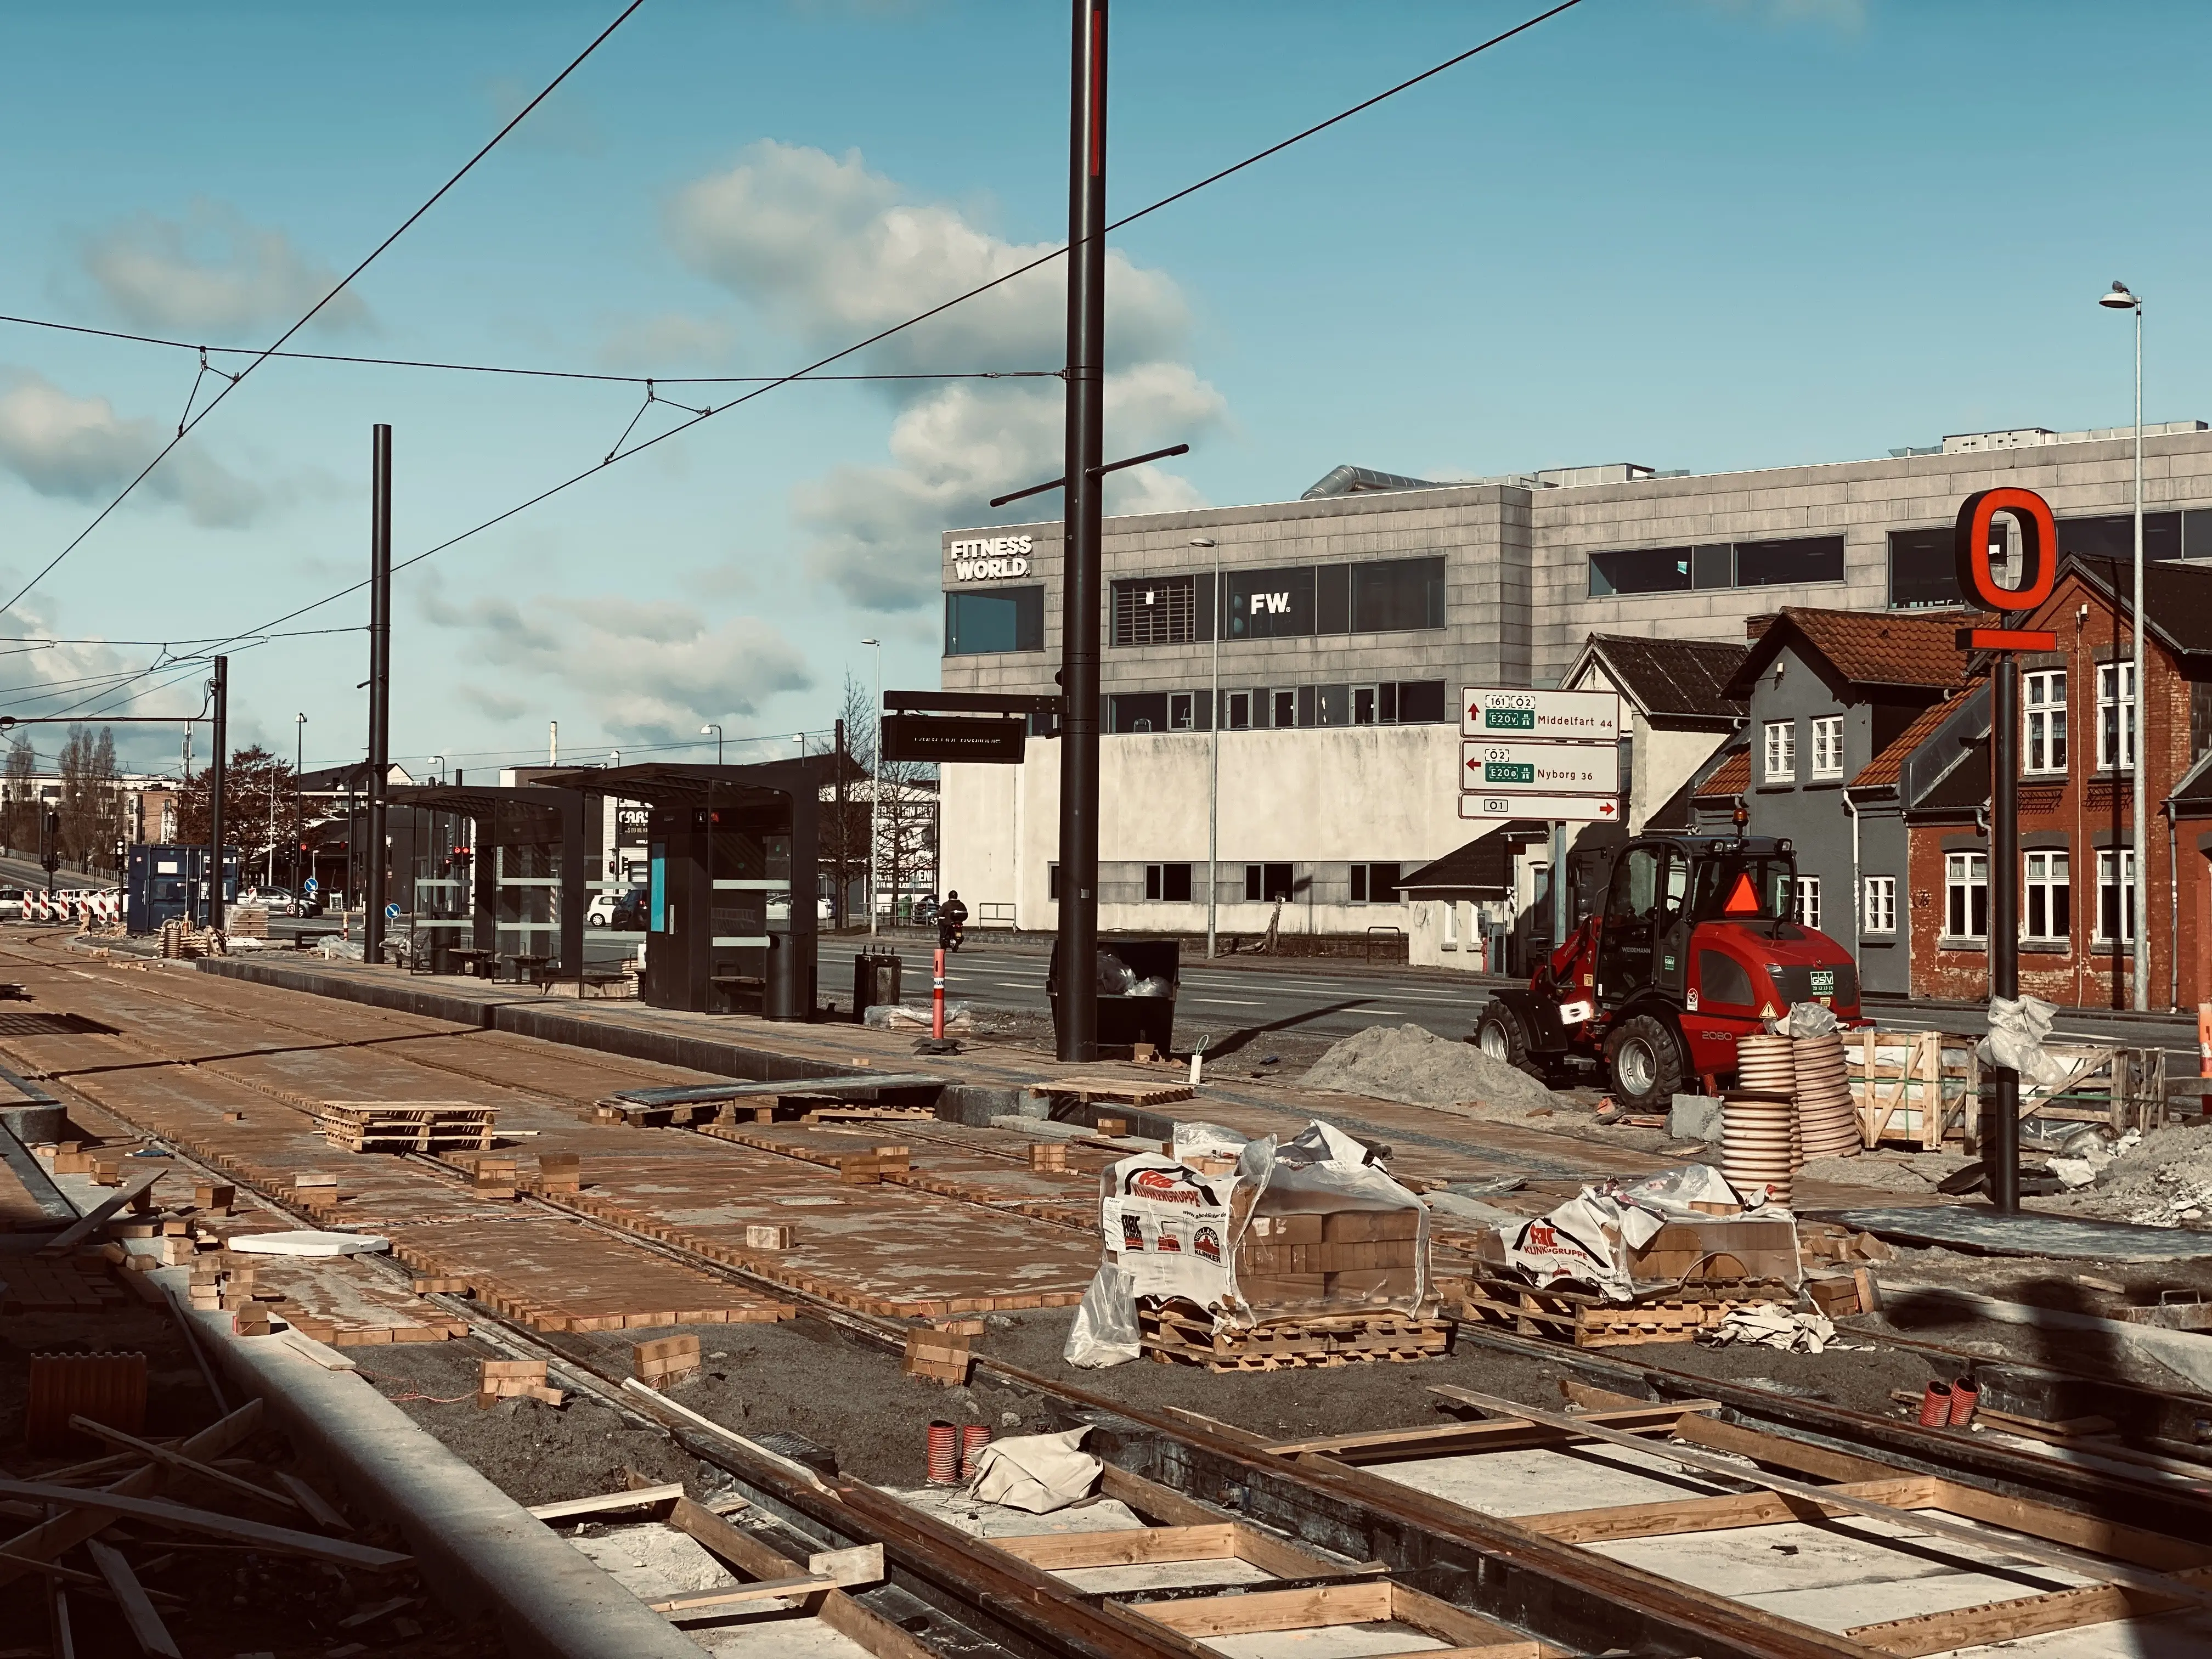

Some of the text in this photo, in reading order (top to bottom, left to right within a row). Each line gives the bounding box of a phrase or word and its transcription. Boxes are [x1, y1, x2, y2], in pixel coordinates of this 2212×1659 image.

[951, 535, 1032, 560] FITNESS
[1491, 698, 1505, 706] 161
[1537, 715, 1595, 727] Middelfart
[1600, 720, 1613, 728] 44
[1537, 769, 1576, 781] Nyborg
[1812, 976, 1833, 985] GSV
[1702, 1031, 1733, 1041] 2080
[1131, 1183, 1201, 1207] KLINKERGRUPPE
[1121, 1214, 1142, 1233] ABC
[1194, 1249, 1221, 1264] KLINKER
[1523, 1245, 1589, 1261] KLINKGRUPPE
